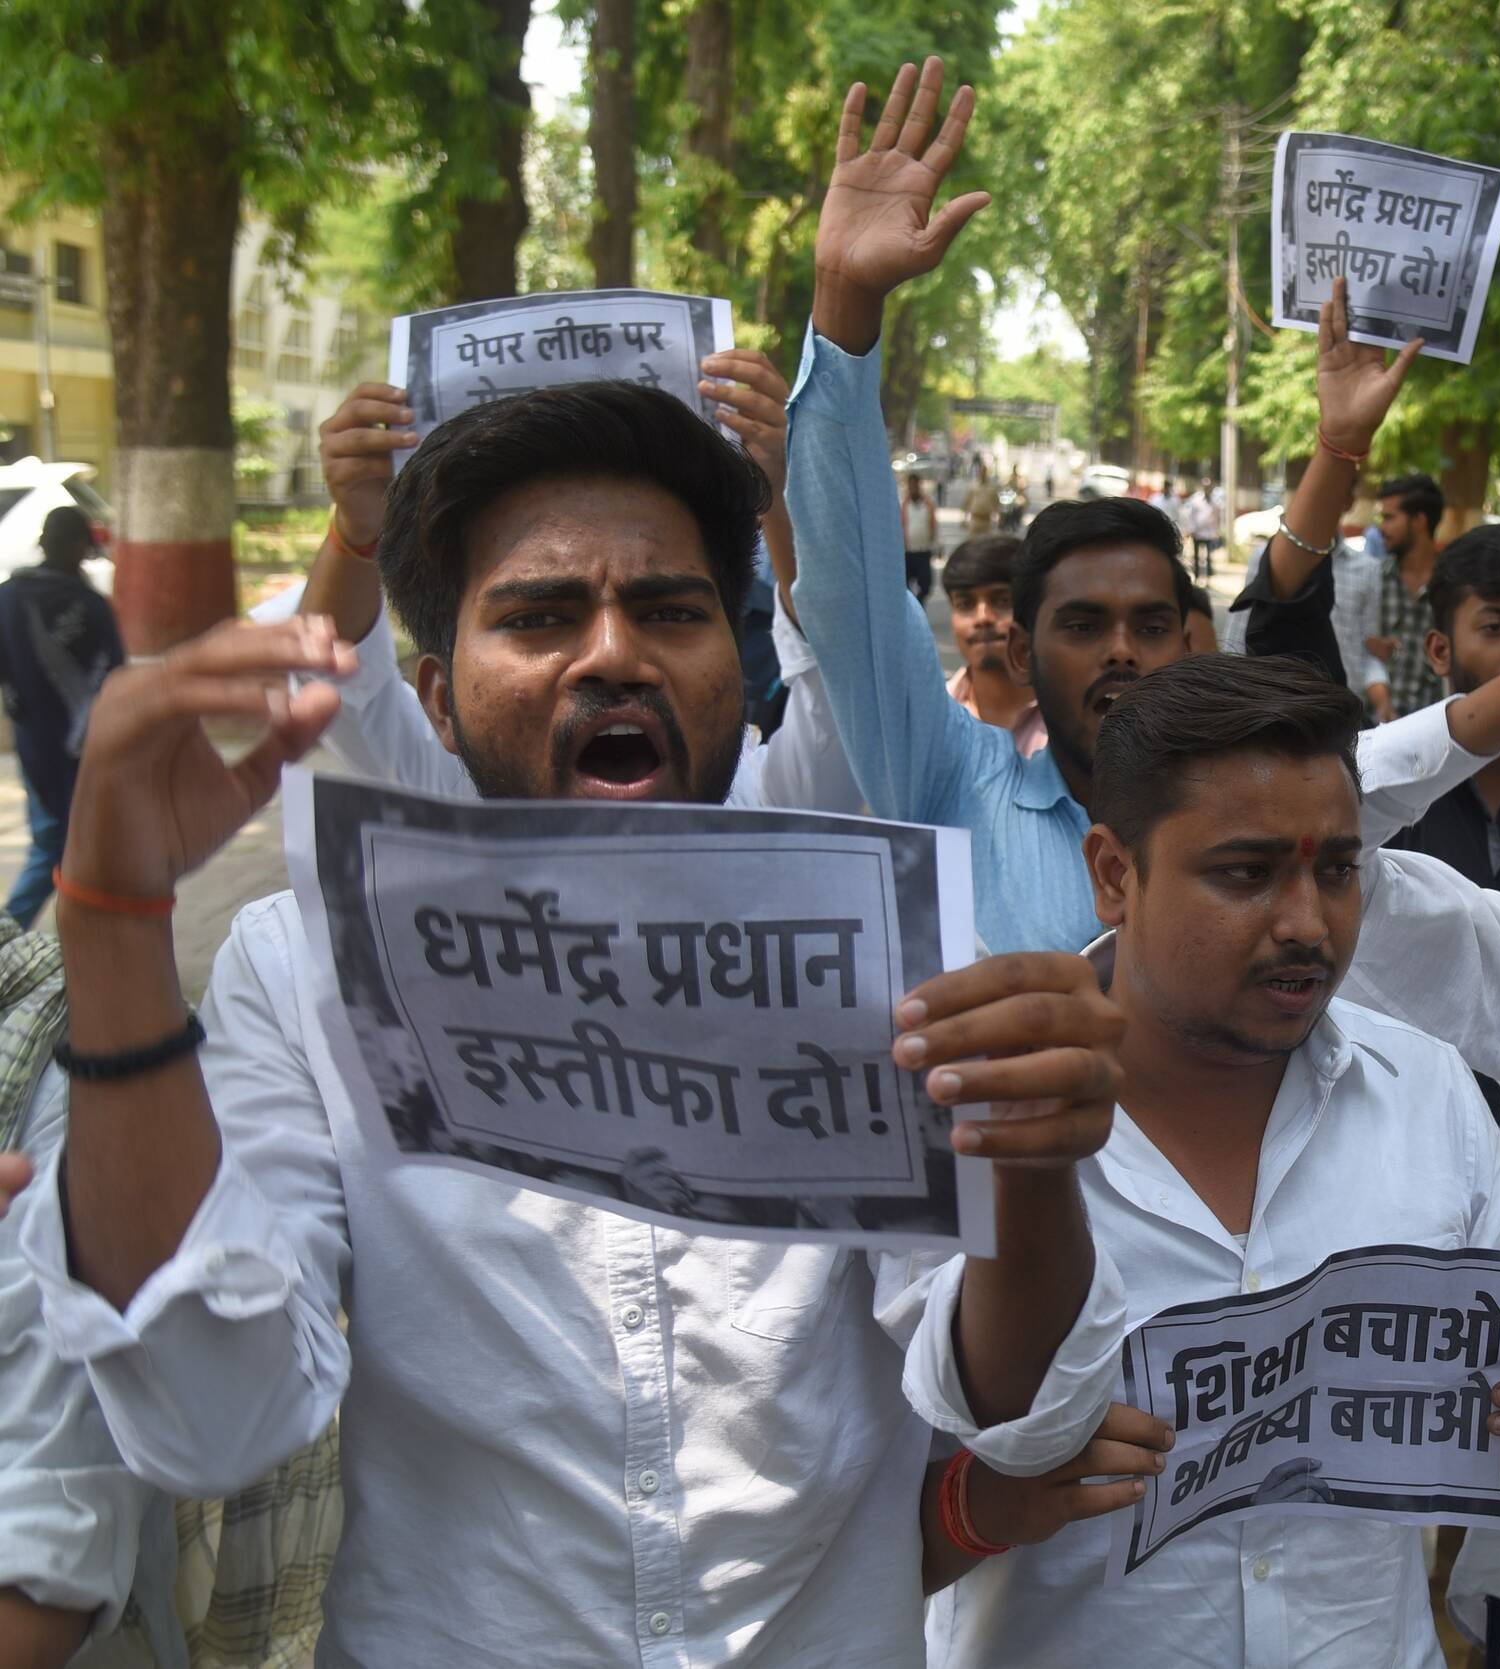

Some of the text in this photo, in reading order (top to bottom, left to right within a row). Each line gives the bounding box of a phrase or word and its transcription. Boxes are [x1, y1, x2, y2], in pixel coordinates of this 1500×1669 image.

[1306, 169, 1462, 236] धर्मेंद्र प्रधान
[1305, 230, 1451, 298] इस्तीफा दो!
[457, 316, 666, 367] पेपर लीक पर
[414, 889, 863, 1008] धर्मेंद्र प्रधान
[445, 1020, 889, 1140] इस्तीफा दो!
[1166, 1318, 1314, 1432] शिक्षा
[1171, 1371, 1492, 1506] भविष्य बचाओ
